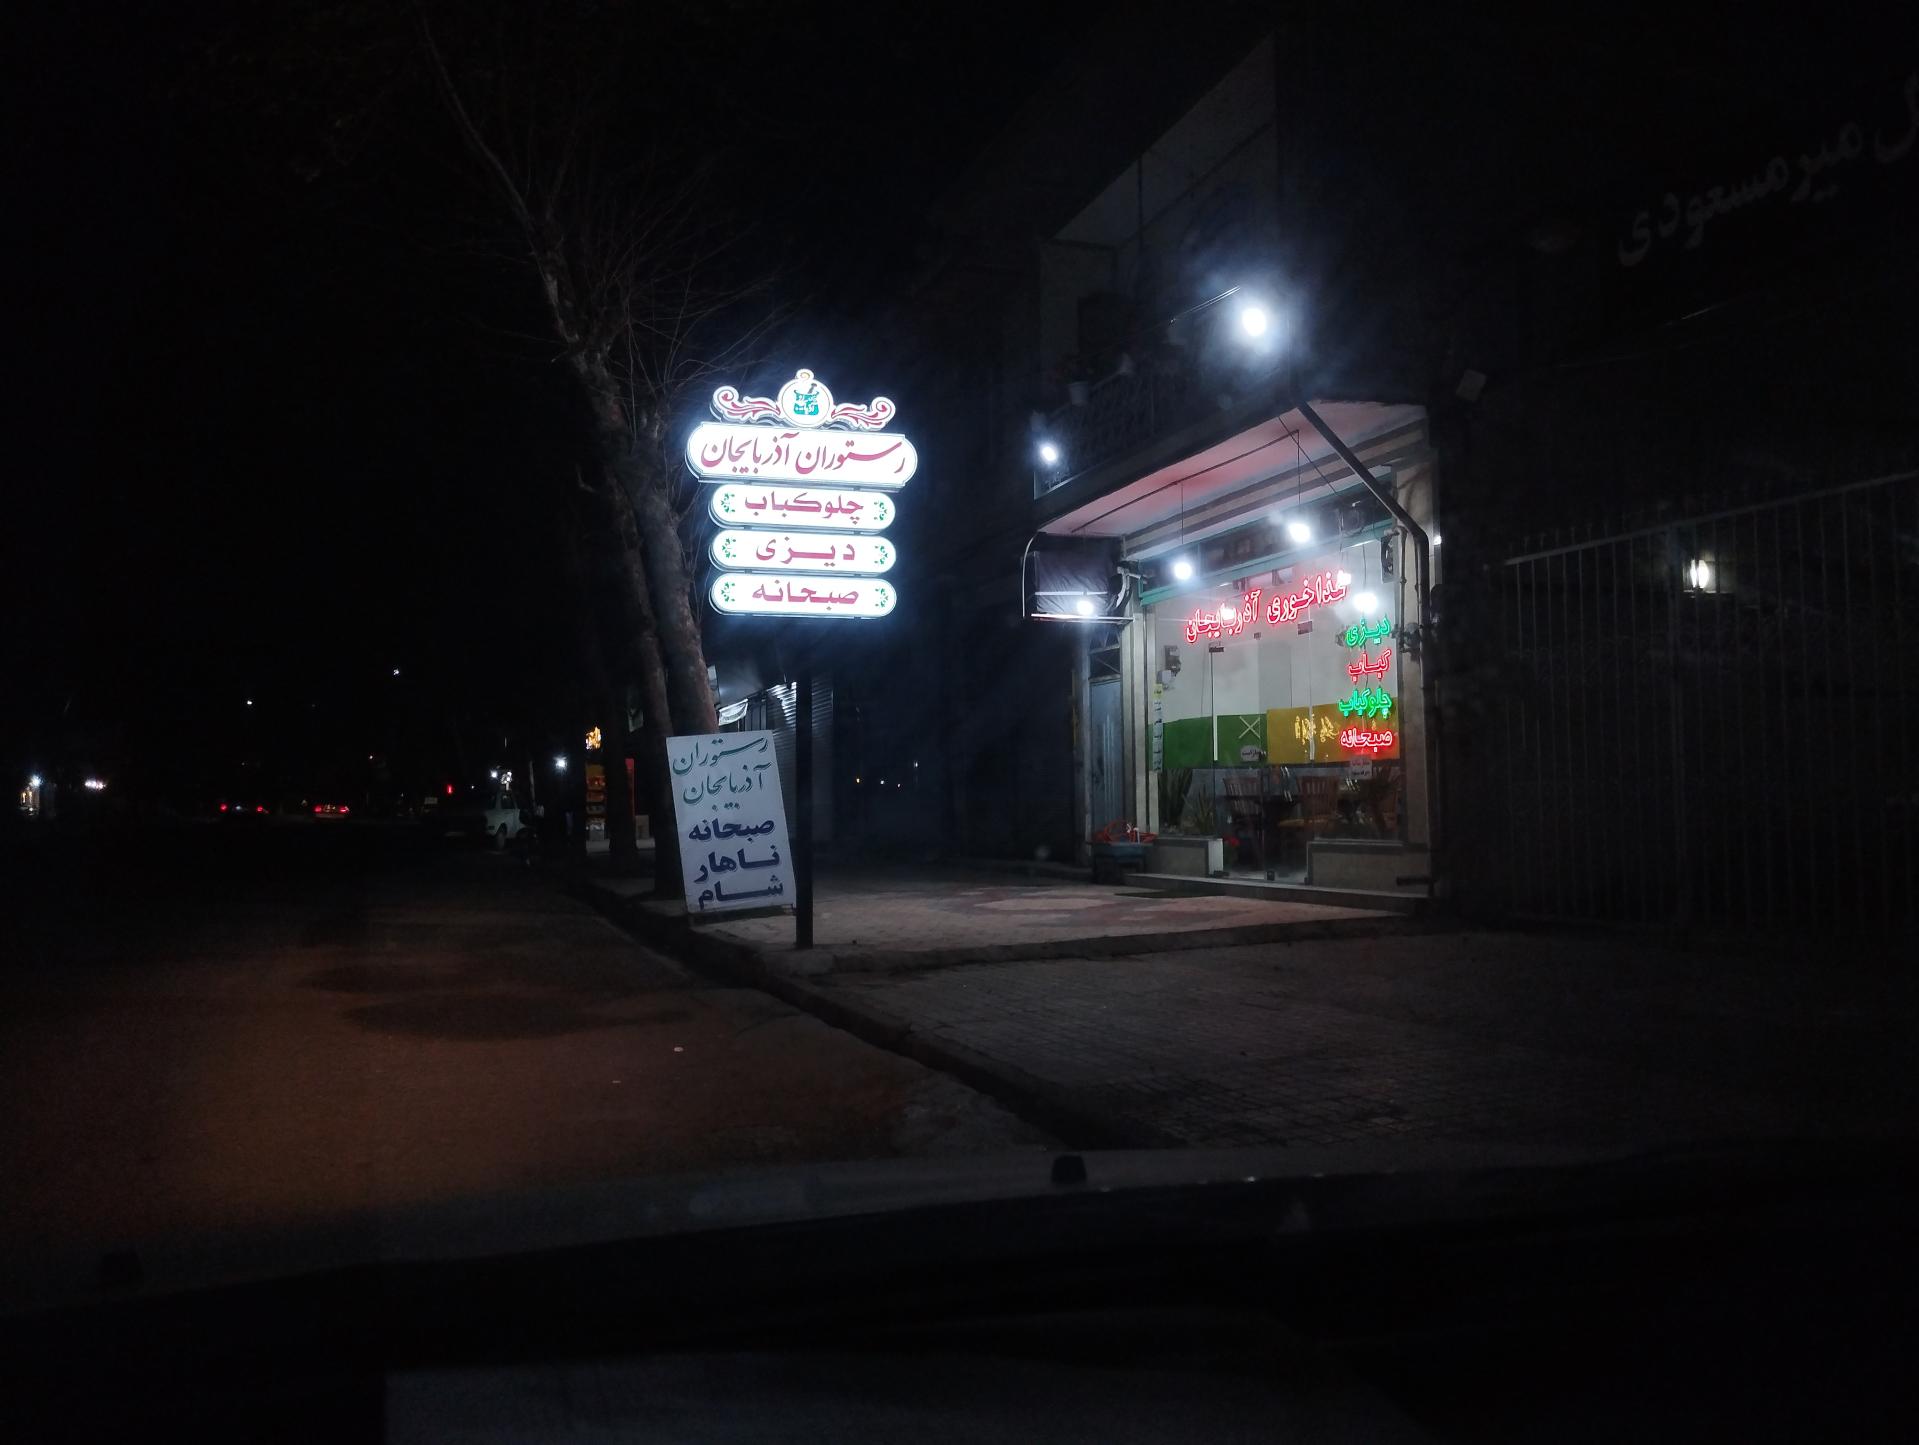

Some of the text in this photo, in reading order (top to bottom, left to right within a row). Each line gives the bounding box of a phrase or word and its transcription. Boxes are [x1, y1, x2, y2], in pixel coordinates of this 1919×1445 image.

[701, 431, 905, 474] رستوران آذربایجان
[745, 491, 864, 525] چلوکباب
[755, 536, 855, 567] دیزی
[752, 579, 859, 611] صبحانه
[1346, 614, 1390, 646] دیزی
[1348, 650, 1391, 682] کباب
[672, 737, 768, 775] رستوران
[1340, 727, 1393, 752] صبحانه
[683, 762, 771, 810] آذربایجان
[688, 818, 774, 842] صبحانه
[694, 845, 780, 883] ناهار
[698, 875, 783, 910] شام
